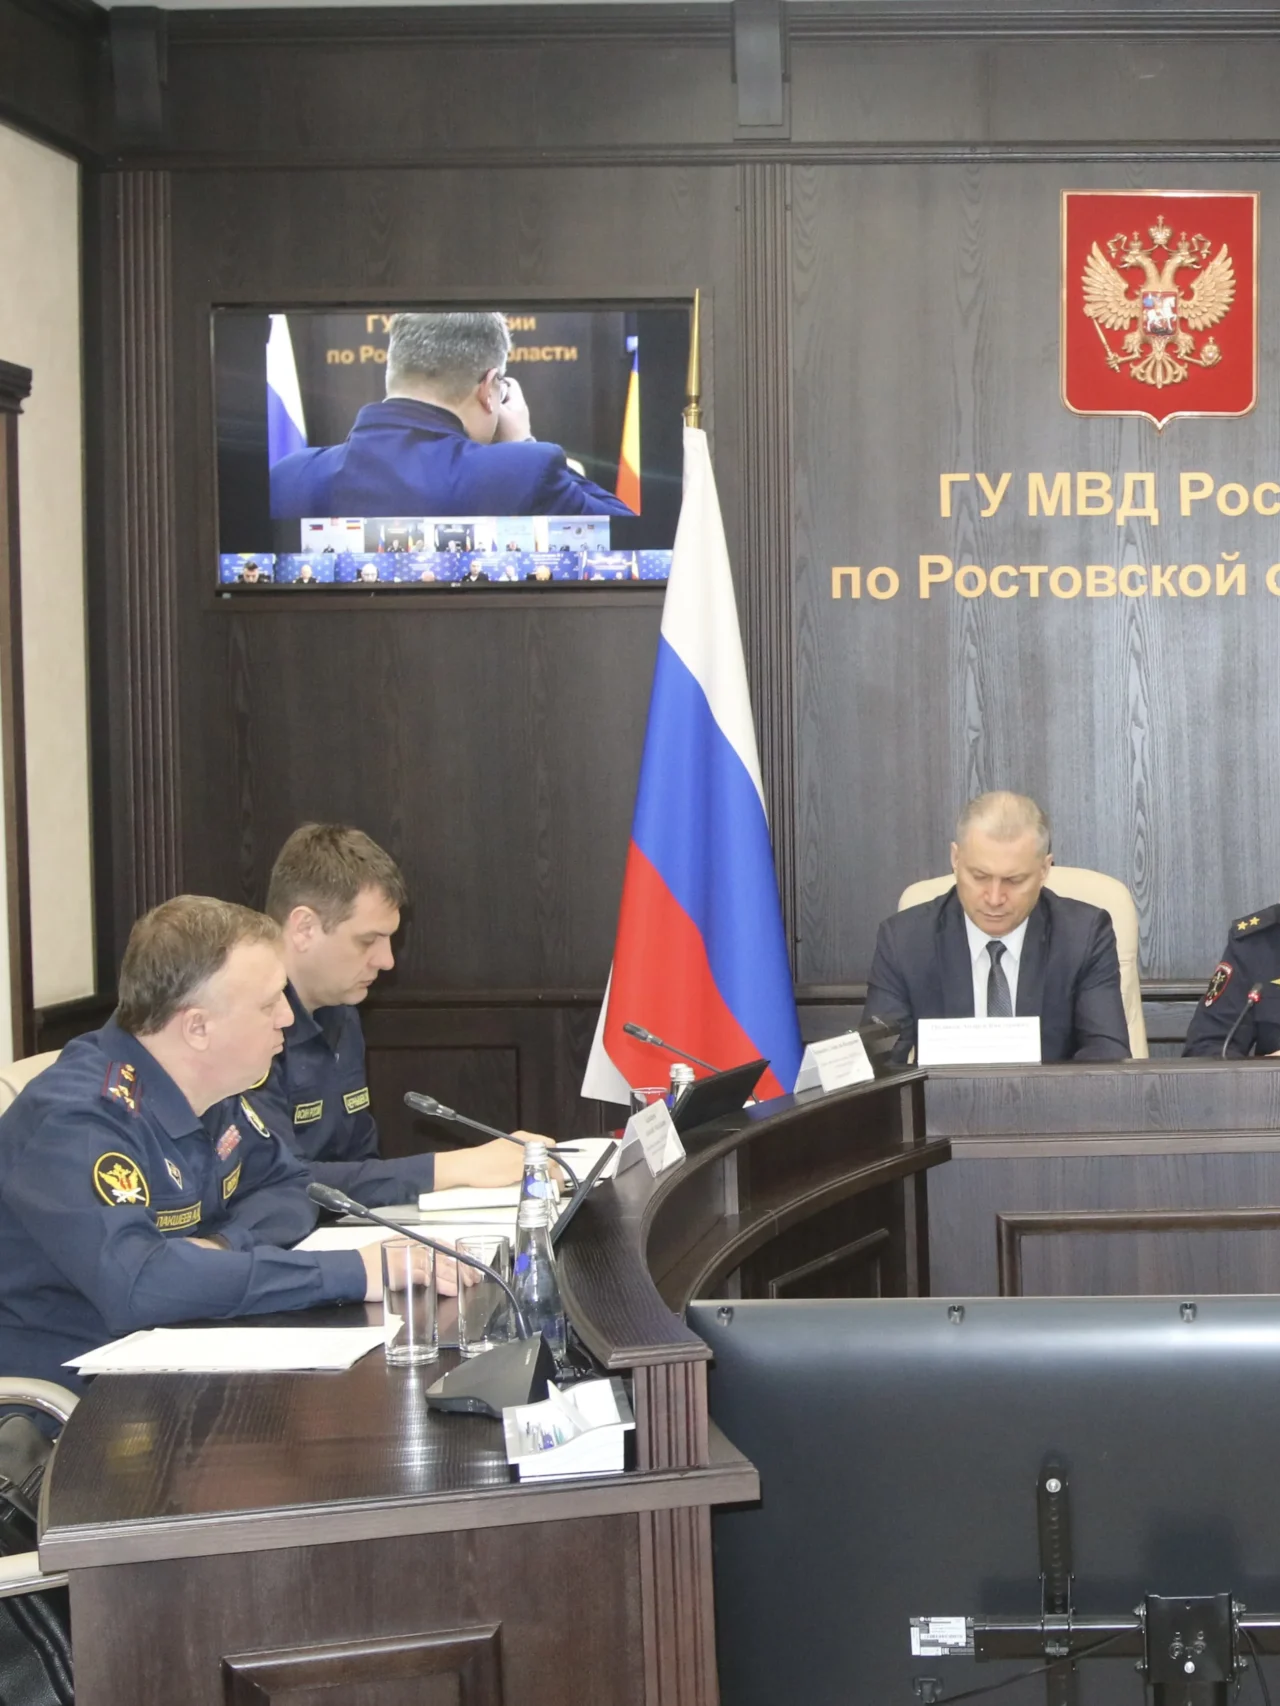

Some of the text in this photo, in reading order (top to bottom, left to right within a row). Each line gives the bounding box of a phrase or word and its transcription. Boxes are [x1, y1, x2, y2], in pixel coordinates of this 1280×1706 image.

[326, 349, 355, 365] по
[940, 472, 1012, 518] ГУ
[1028, 471, 1159, 526] МВД
[831, 566, 900, 600] по
[919, 551, 1247, 600] Ростовской
